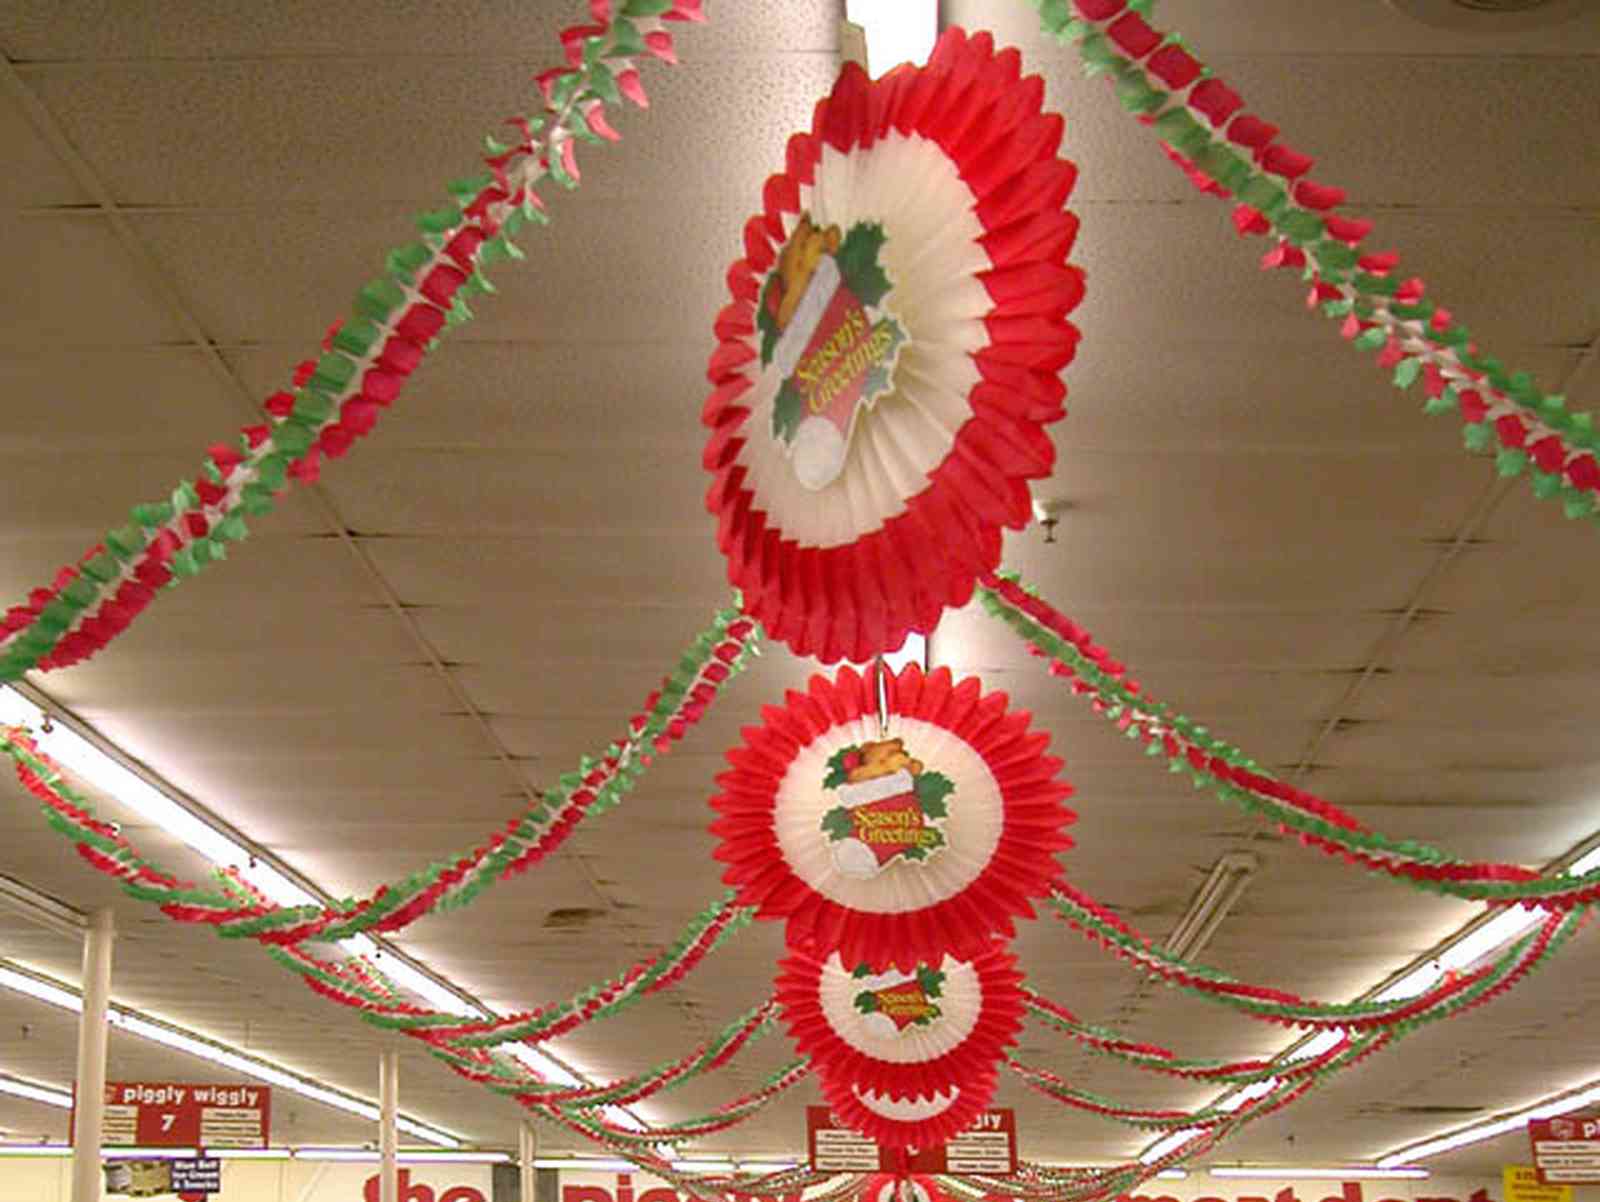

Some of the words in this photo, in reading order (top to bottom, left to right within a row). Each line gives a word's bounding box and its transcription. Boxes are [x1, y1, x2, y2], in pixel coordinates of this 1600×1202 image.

[123, 1085, 187, 1103] piggly
[193, 1087, 259, 1106] wiggly
[161, 1115, 175, 1131] 7
